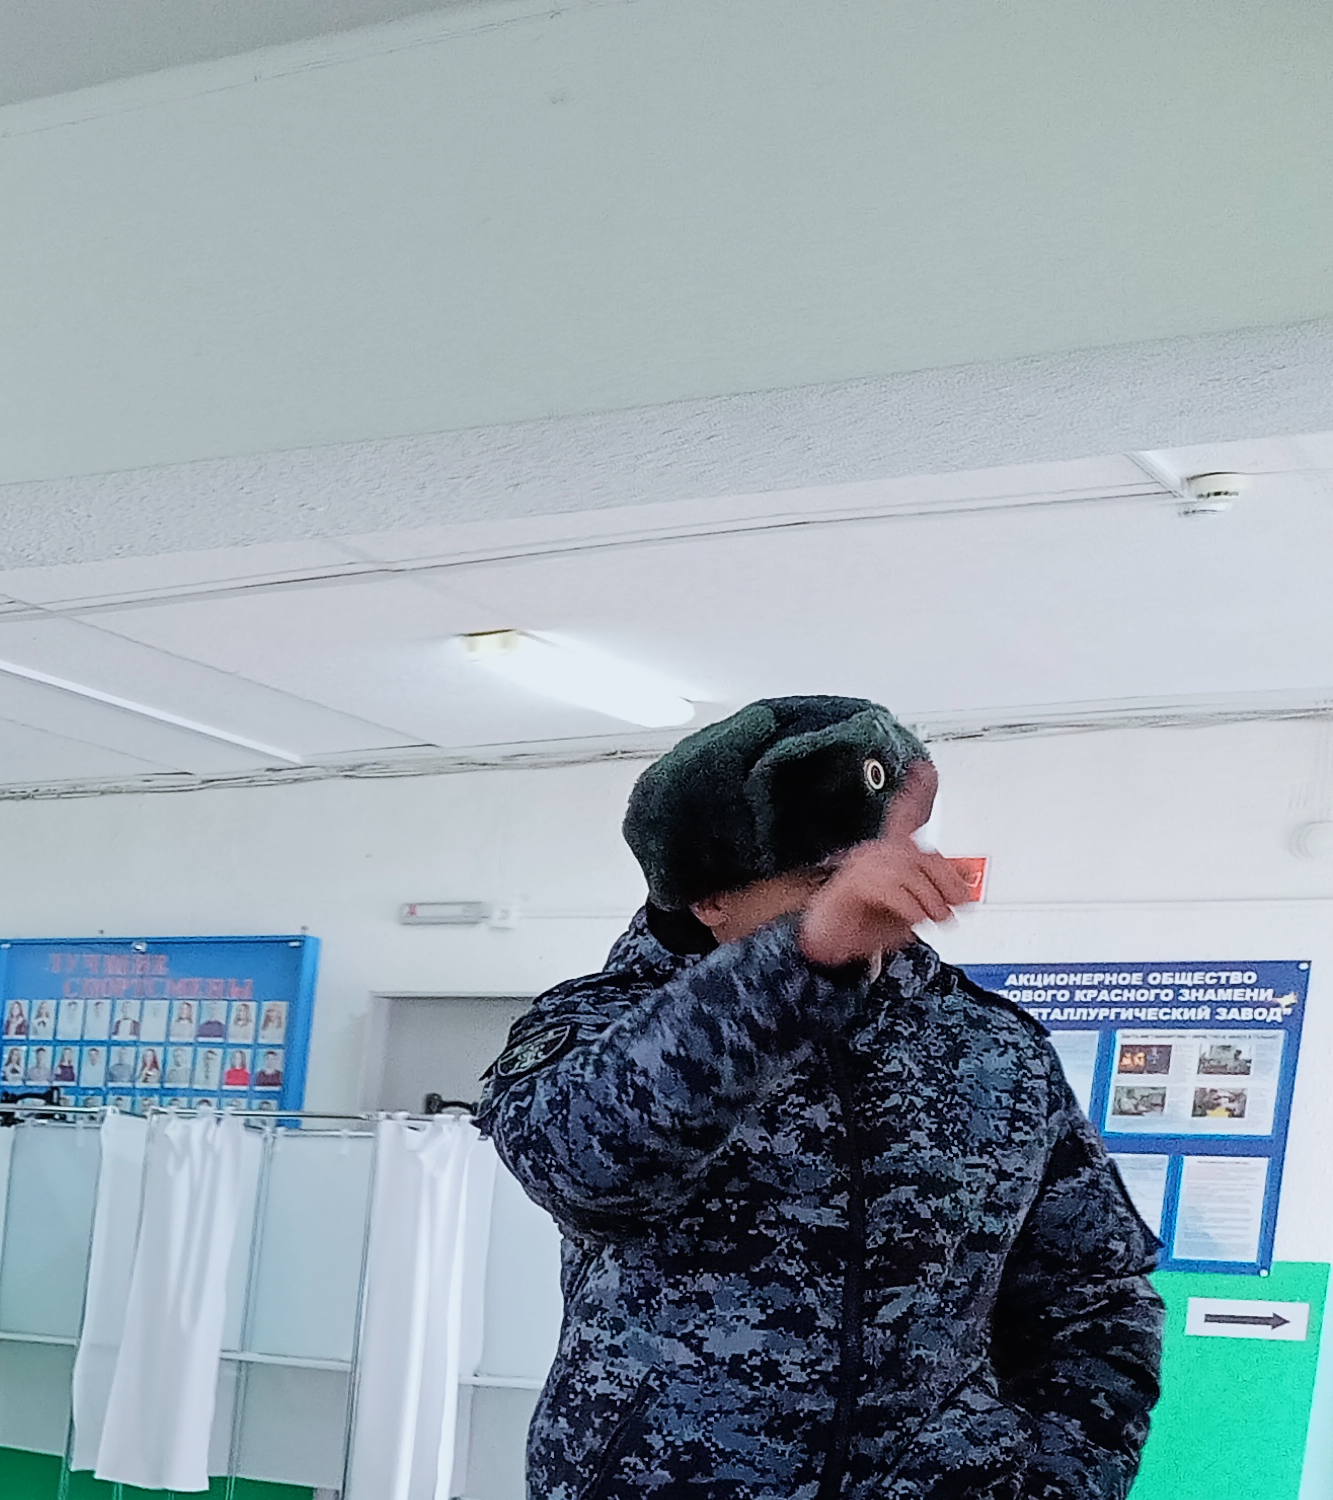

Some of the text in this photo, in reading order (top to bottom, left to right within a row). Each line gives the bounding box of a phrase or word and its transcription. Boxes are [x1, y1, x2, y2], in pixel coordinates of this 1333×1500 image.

[1004, 971, 1257, 988] АКЦИОНЕРНОЕ ОБЩЕСТВО
[1074, 989, 1174, 1002] КРАСНОГО
[1177, 988, 1273, 1002] ЗНАМЕНИ
[1023, 1006, 1211, 1021] ЕТАЛЛУРГИЧЕСКИЙ
